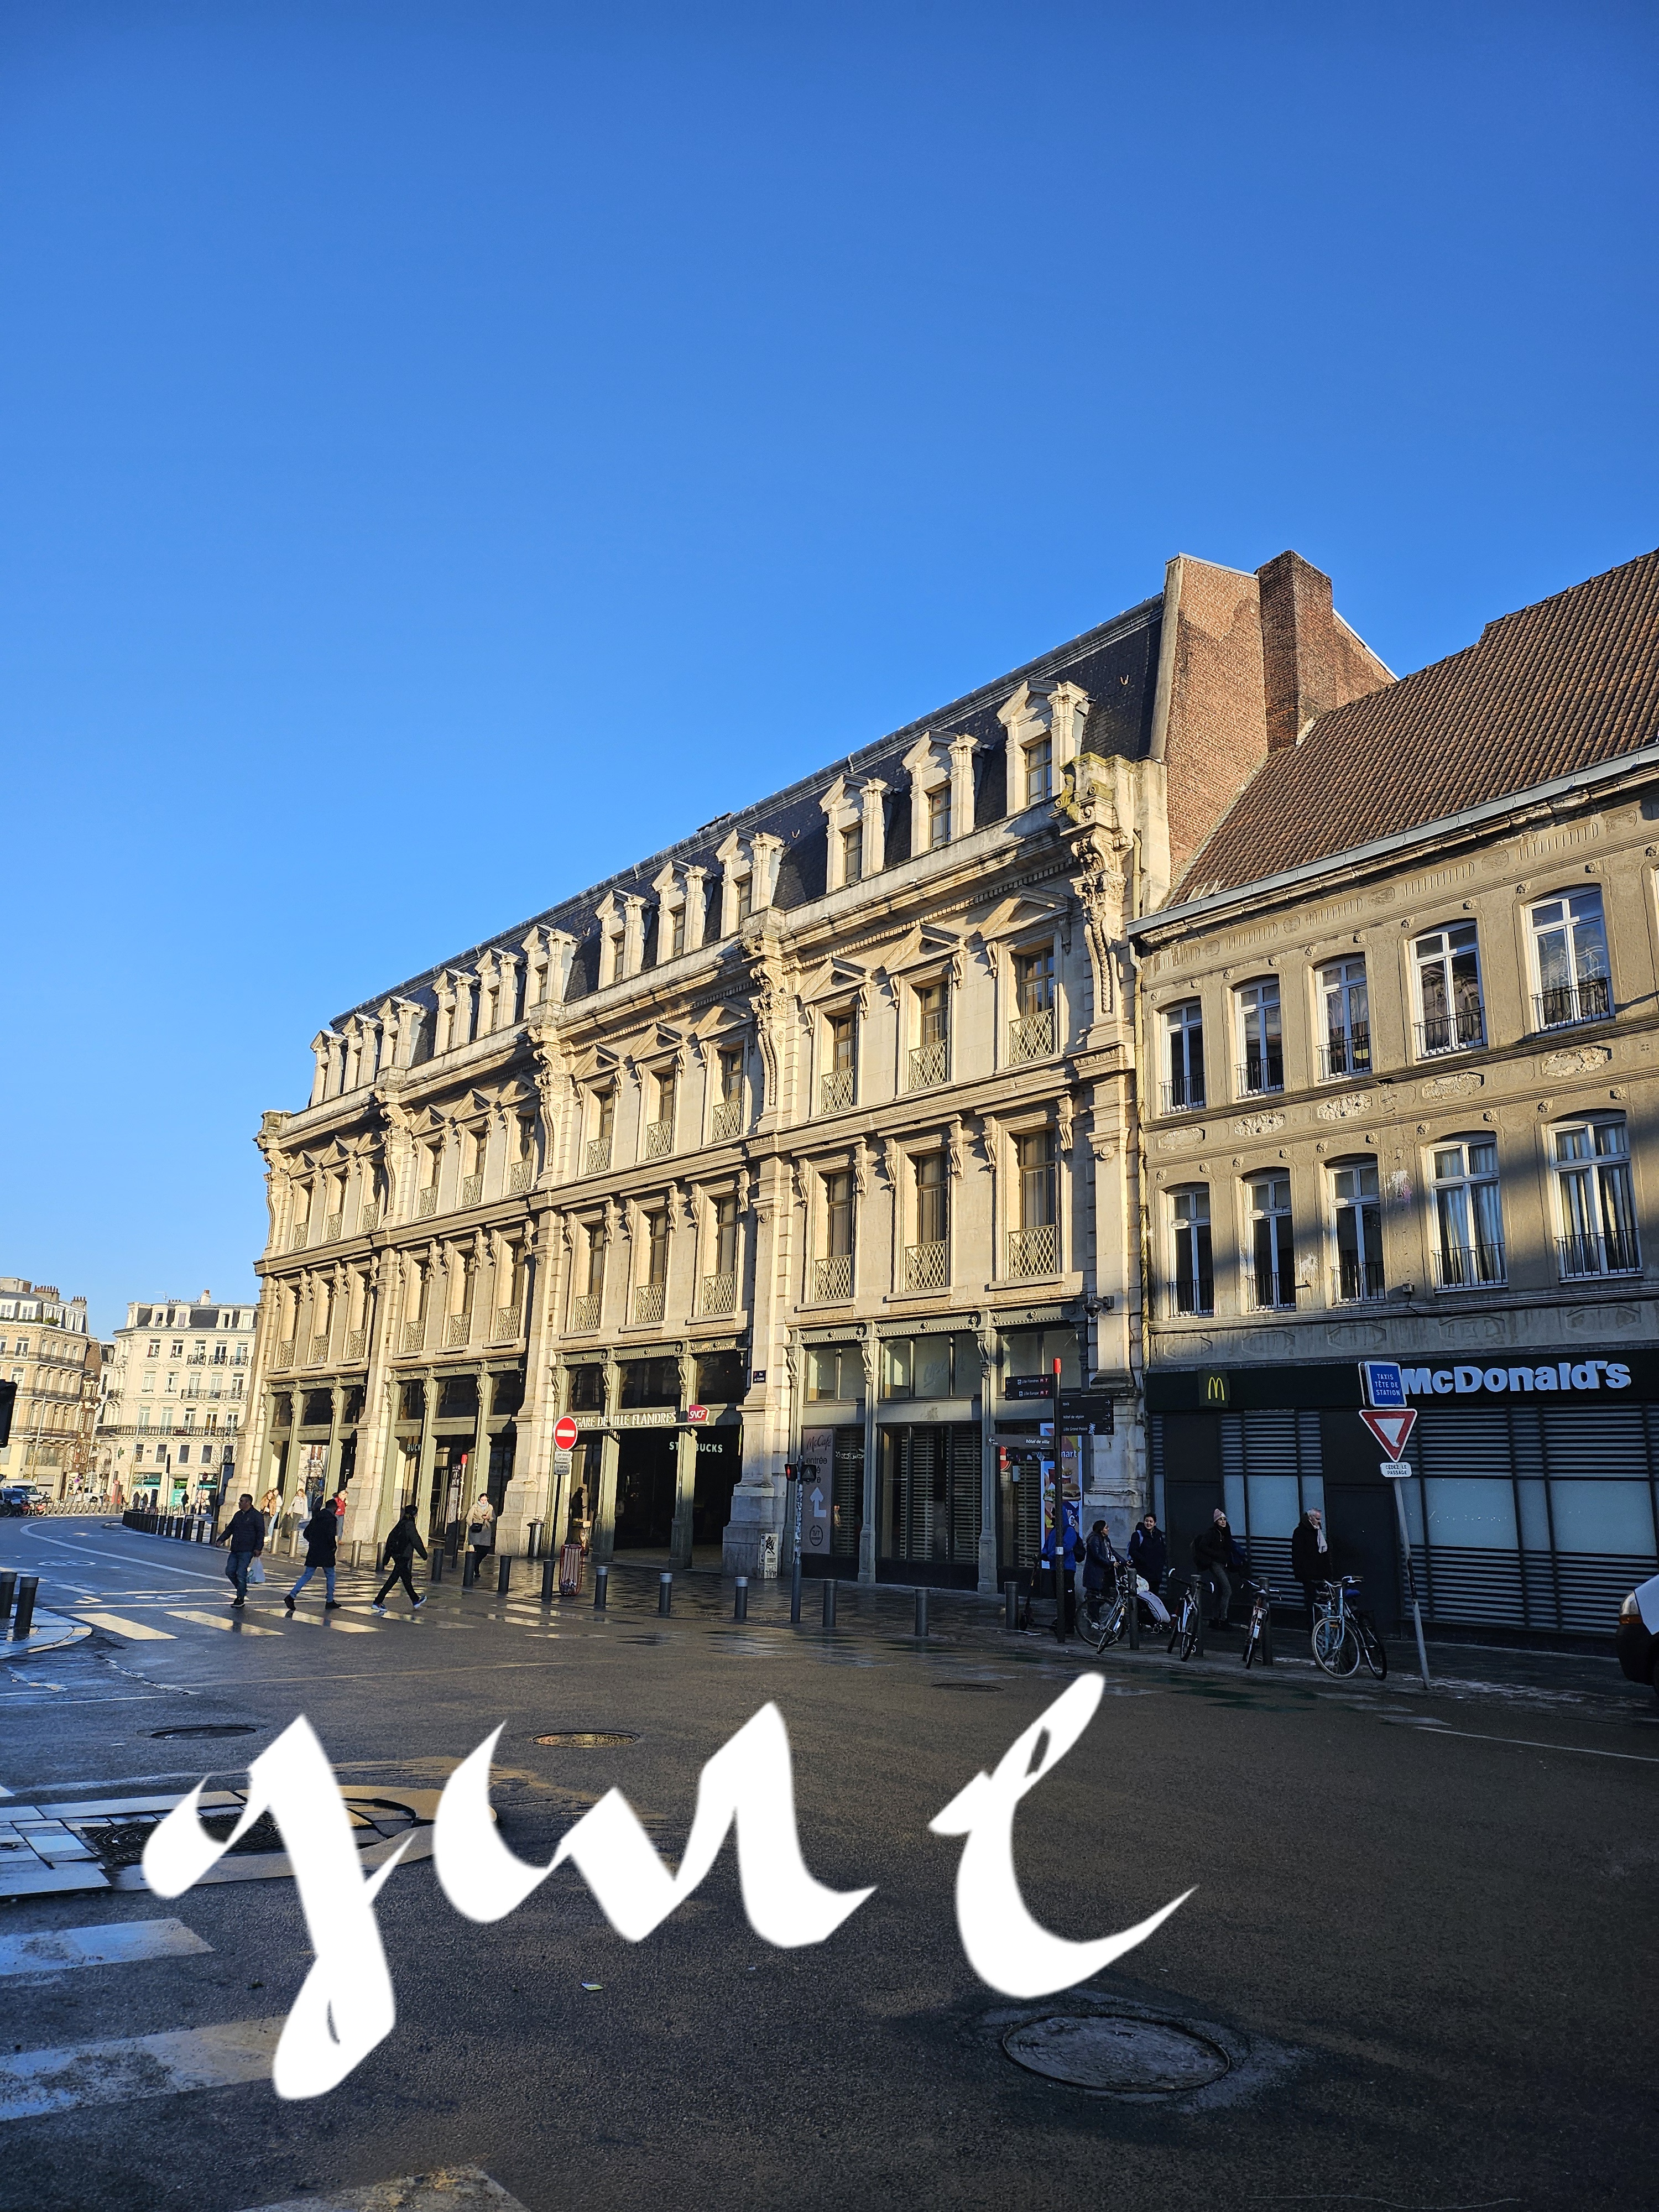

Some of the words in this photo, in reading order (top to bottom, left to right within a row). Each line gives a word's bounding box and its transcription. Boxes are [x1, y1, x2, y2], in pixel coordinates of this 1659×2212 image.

[1402, 1360, 1632, 1394] McDonald's
[575, 1416, 596, 1427] GARE
[597, 1416, 608, 1427] DE
[611, 1415, 629, 1426] LILLE
[632, 1412, 676, 1426] FLANDRES
[688, 1410, 706, 1420] SNCF
[669, 1441, 723, 1453] STBUCKS
[806, 1434, 832, 1452] McCafé
